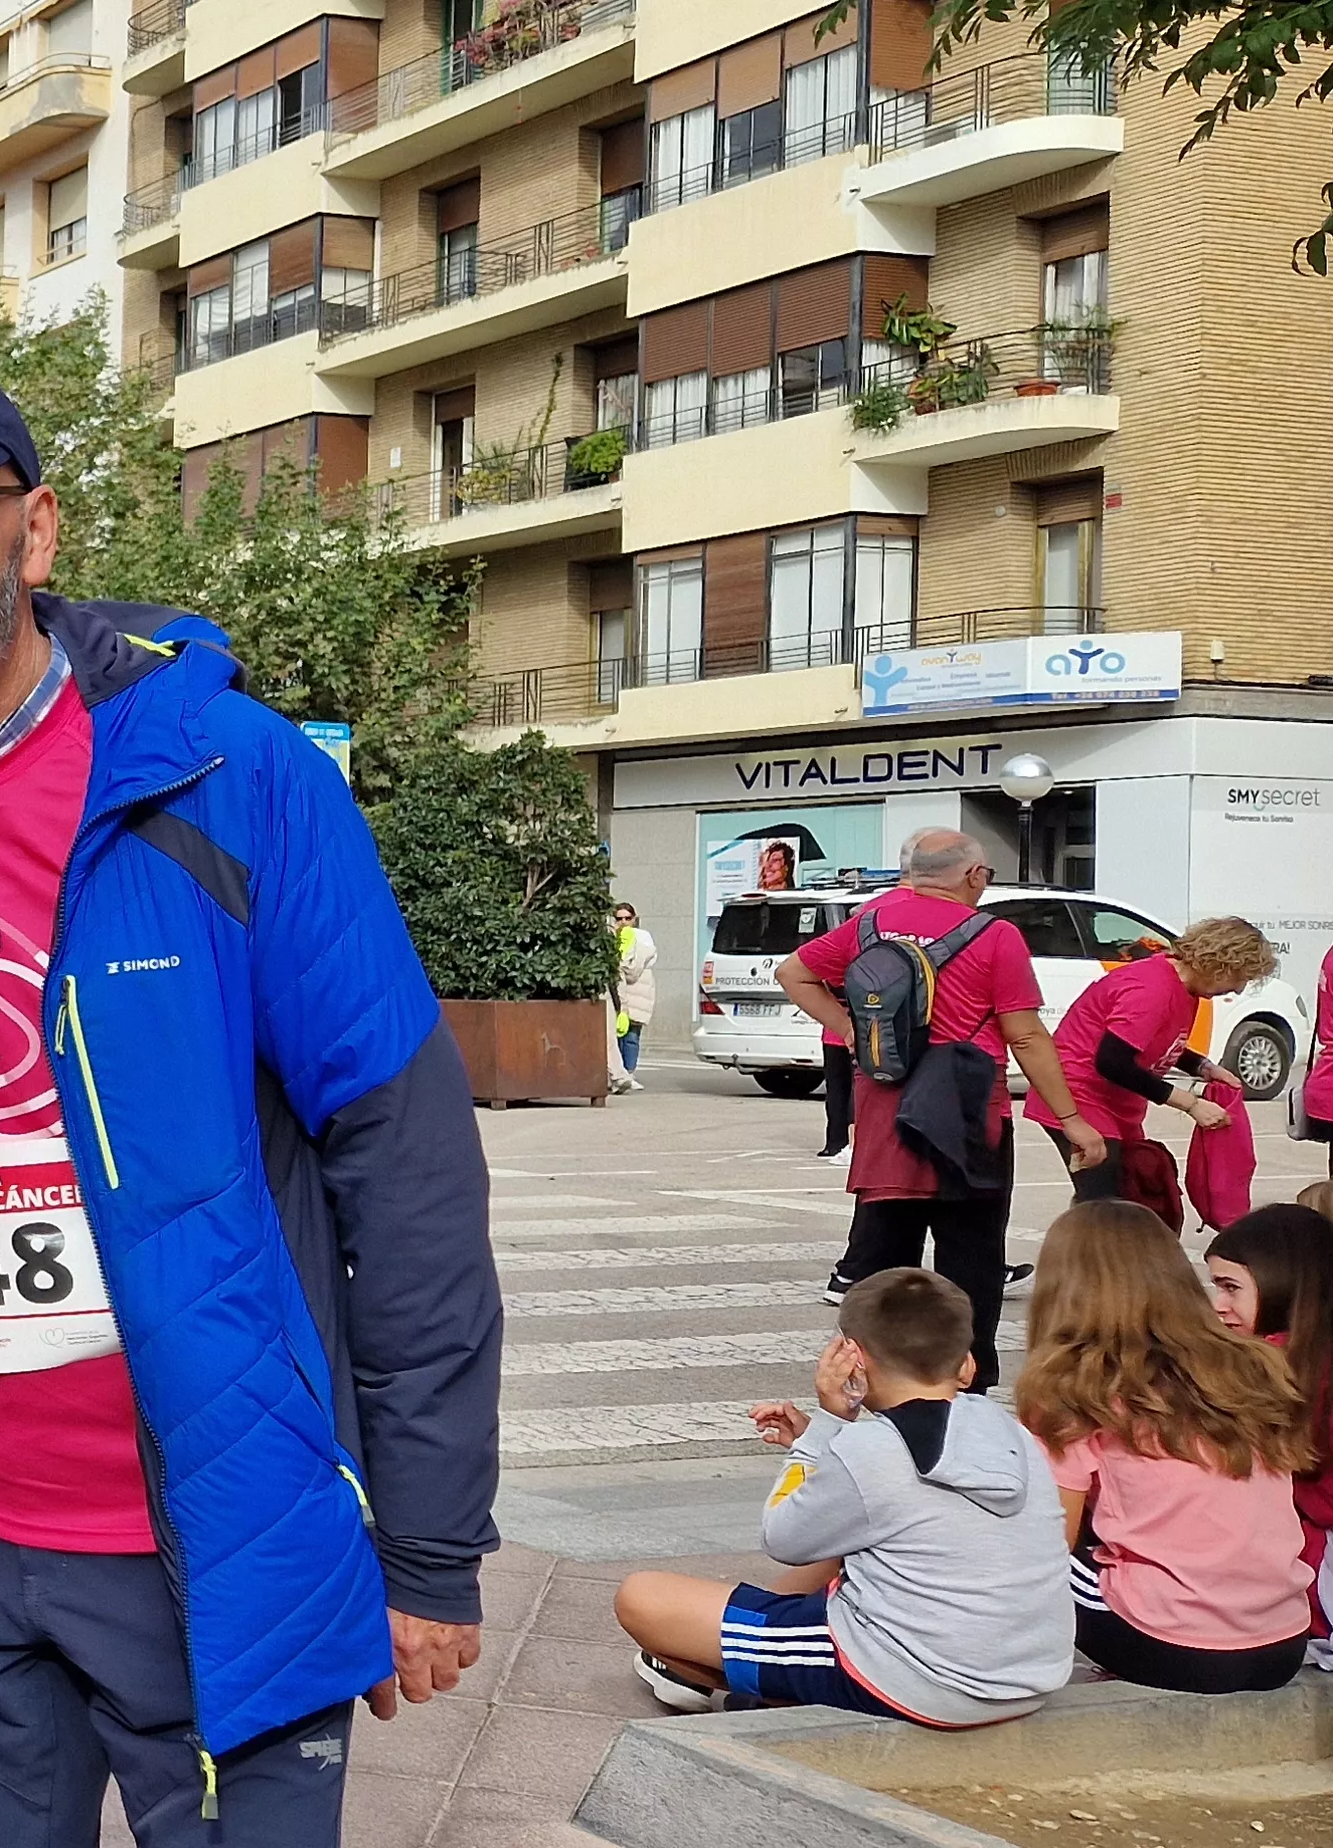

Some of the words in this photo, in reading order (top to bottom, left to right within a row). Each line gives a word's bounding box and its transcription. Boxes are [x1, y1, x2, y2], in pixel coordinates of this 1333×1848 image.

[735, 743, 1002, 789] VITALDENT
[1278, 920, 1306, 930] MEJOR
[123, 955, 180, 972] SIMOND
[715, 976, 770, 986] PROTECCIÓN
